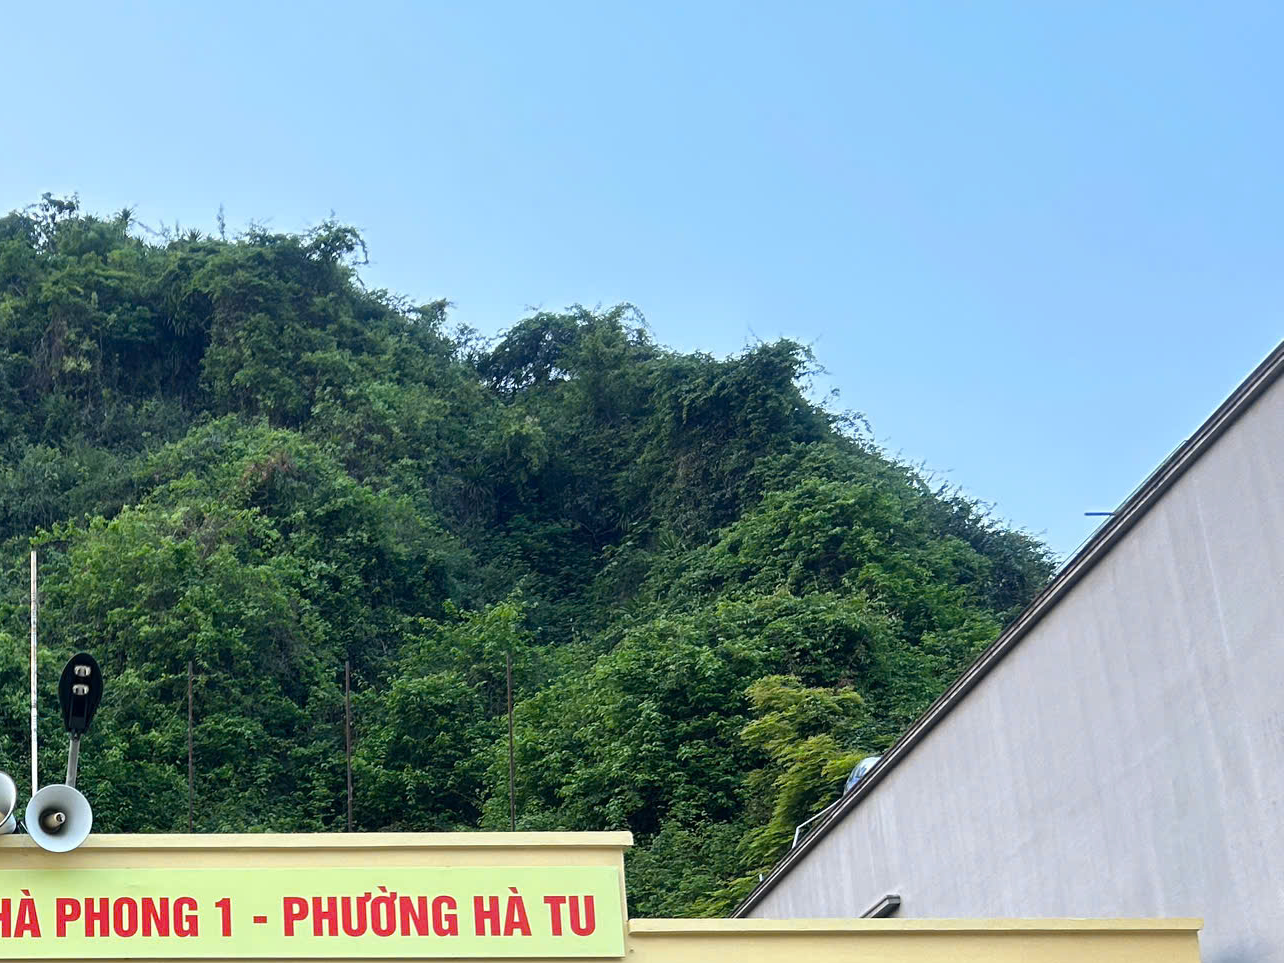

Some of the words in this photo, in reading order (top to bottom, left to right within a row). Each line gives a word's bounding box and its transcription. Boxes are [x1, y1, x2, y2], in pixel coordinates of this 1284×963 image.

[56, 896, 199, 937] PHONG
[215, 896, 232, 937] 1
[283, 886, 459, 936] PHƯỜNG
[473, 886, 532, 936] HÀ
[543, 894, 596, 936] TU
